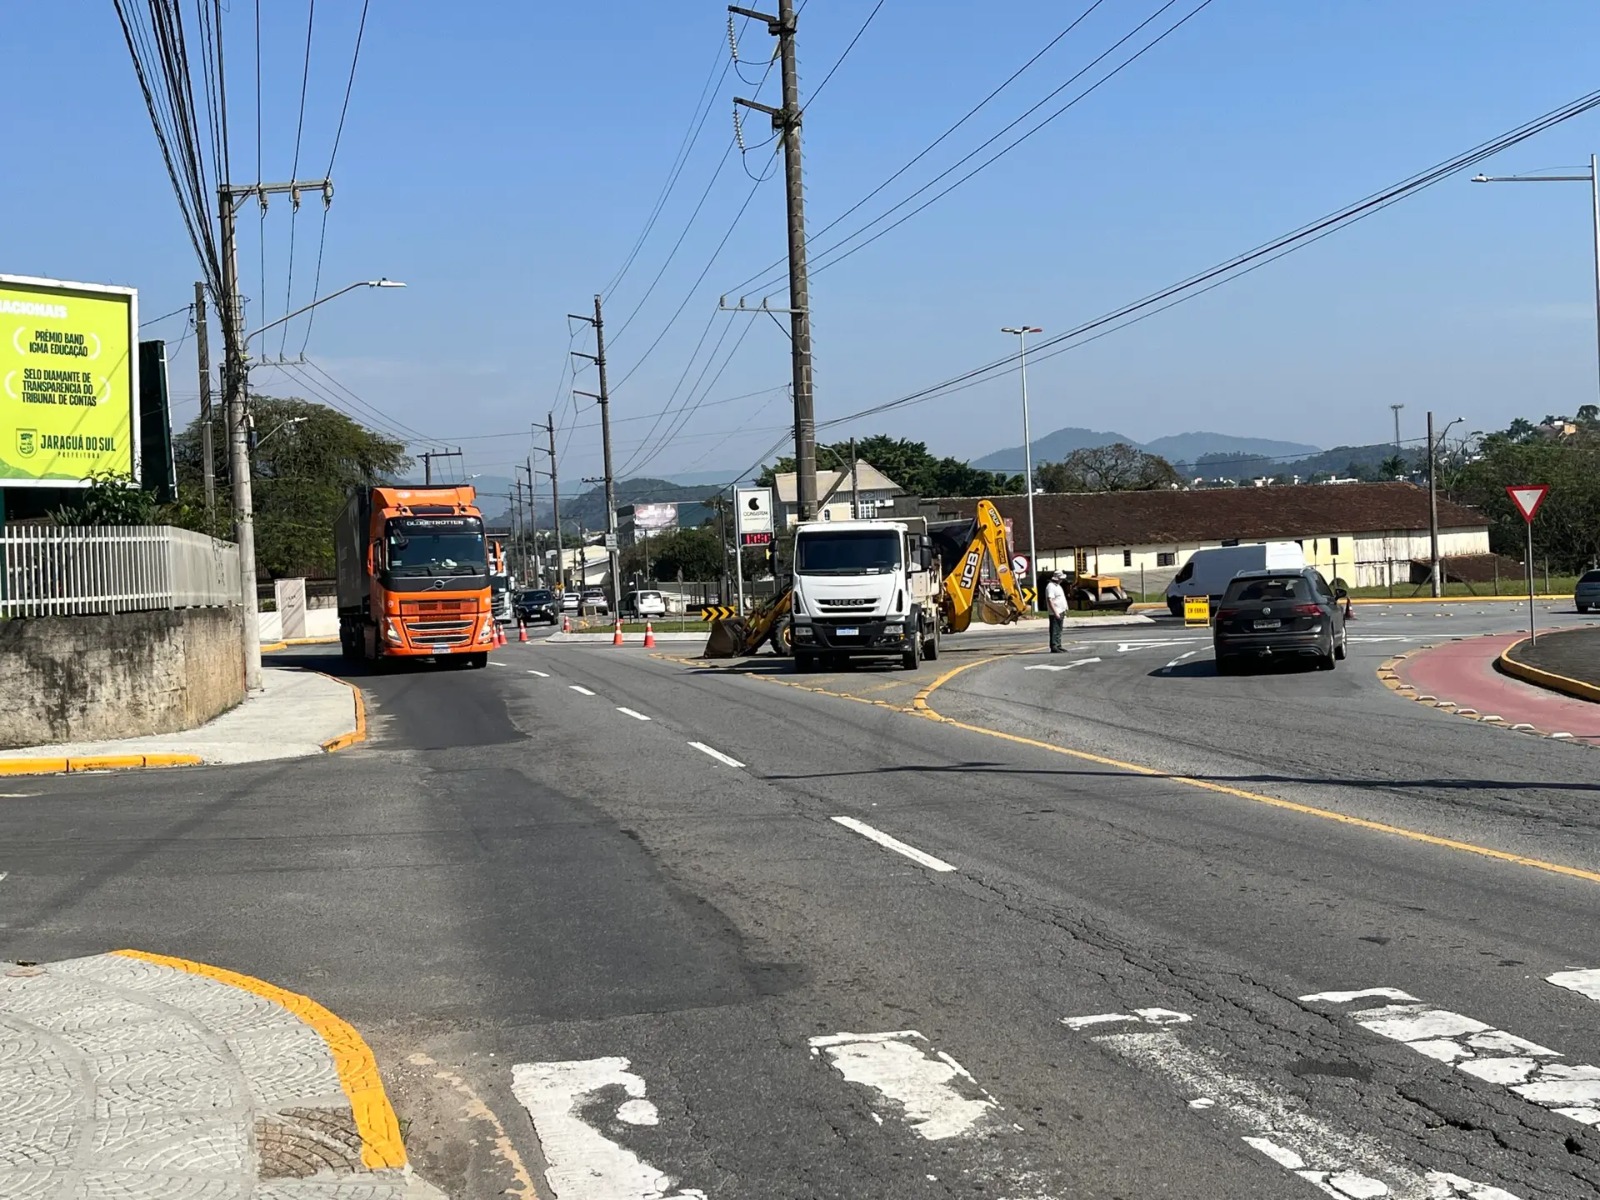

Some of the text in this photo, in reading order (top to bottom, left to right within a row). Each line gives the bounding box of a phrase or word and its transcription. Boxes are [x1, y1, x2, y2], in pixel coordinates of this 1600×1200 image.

[64, 333, 84, 345] BAND
[29, 342, 48, 353] IGMA
[24, 368, 91, 383] SELO DIAMANTE DE
[83, 384, 93, 395] DO
[22, 392, 96, 406] TRIBUNAL DE CONTAS
[40, 434, 116, 452] JARAGUÁ DO SUL
[960, 552, 979, 588] JCB
